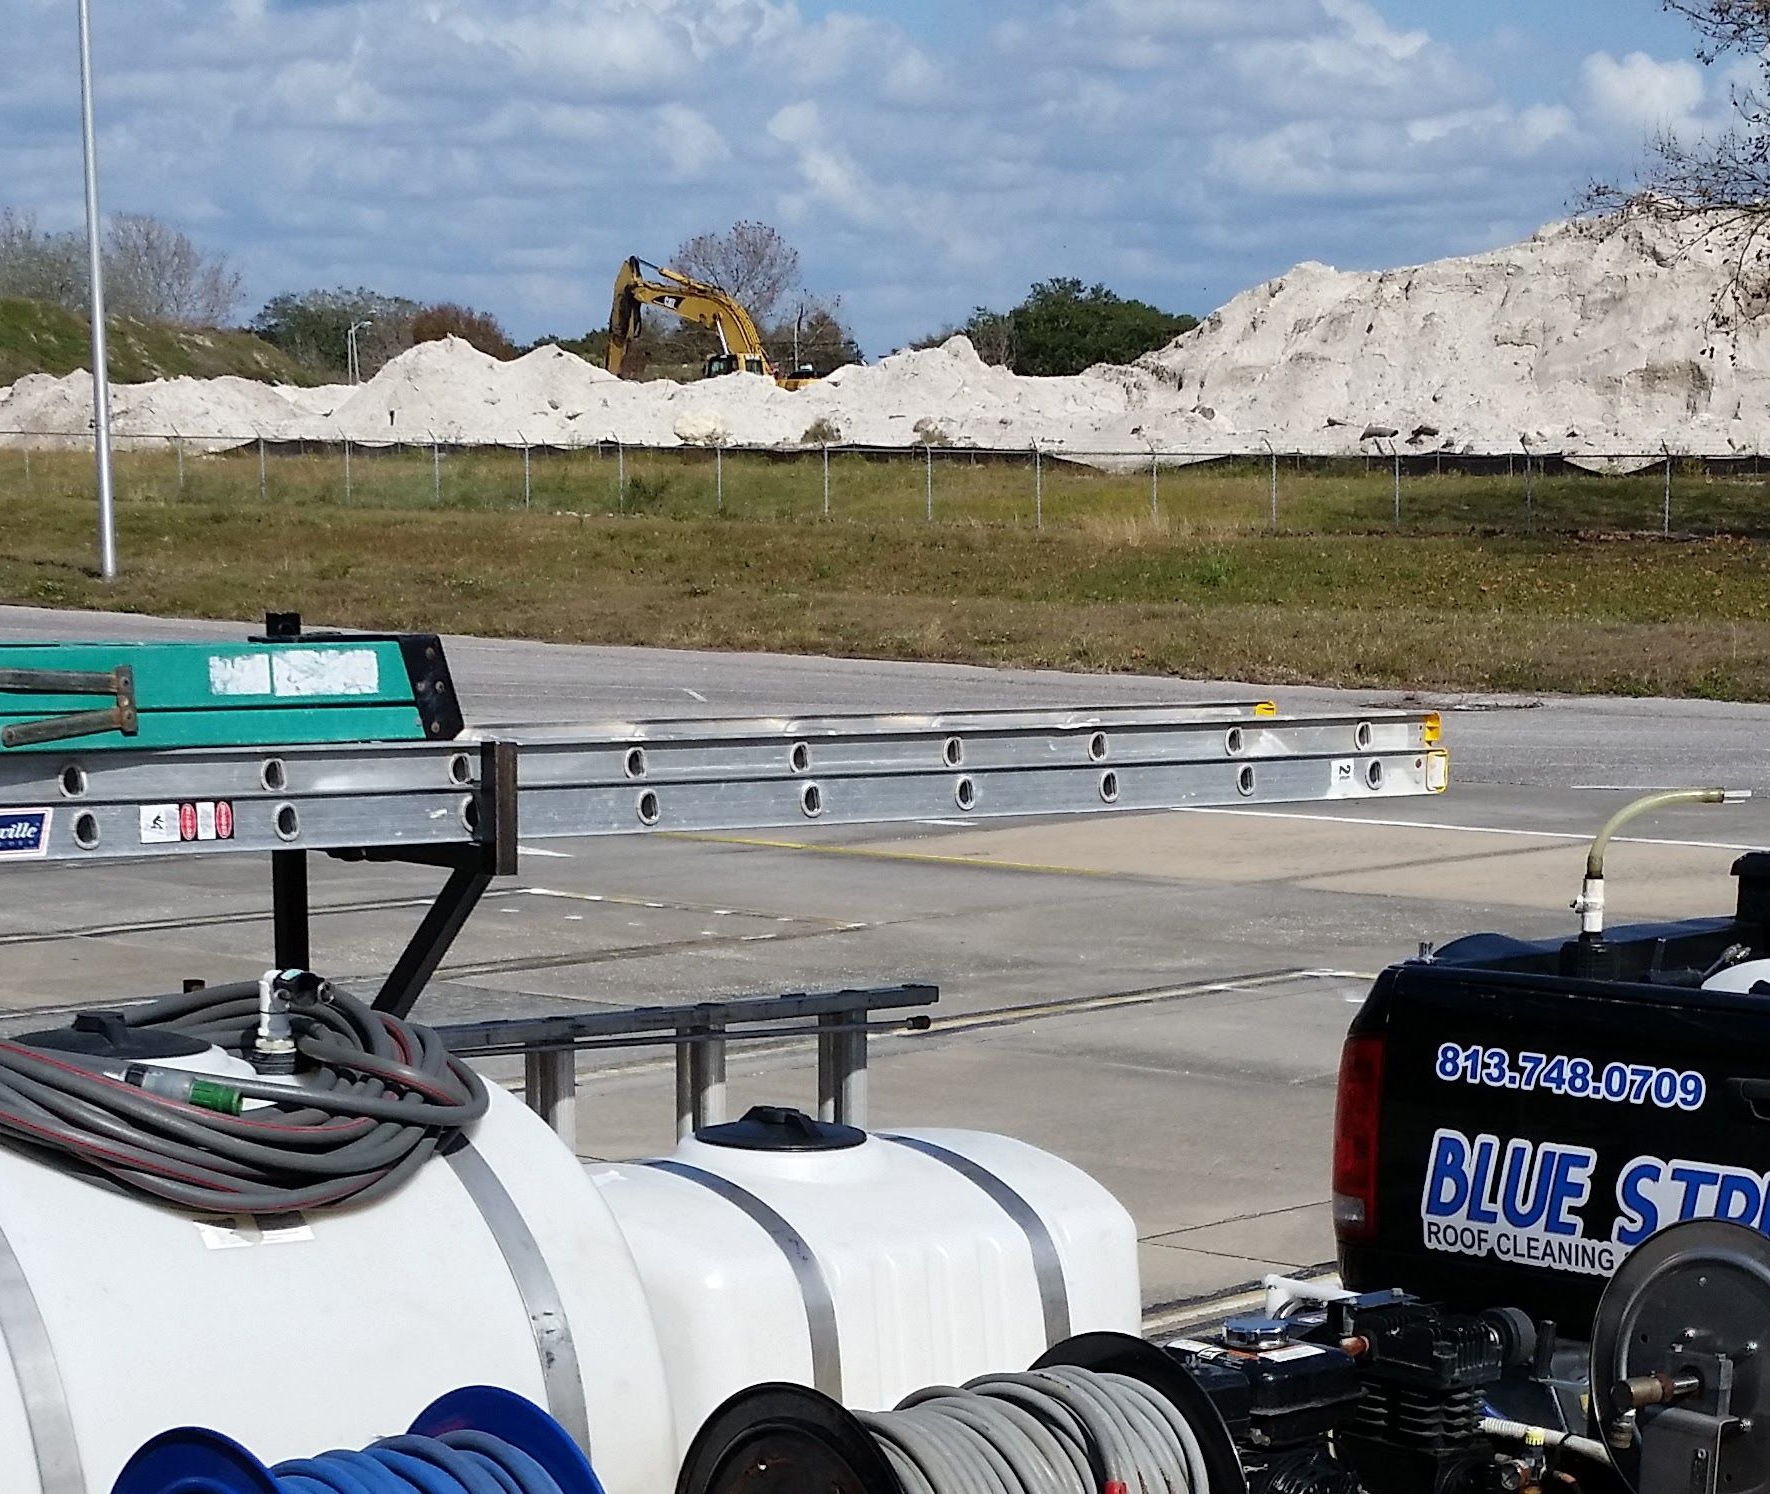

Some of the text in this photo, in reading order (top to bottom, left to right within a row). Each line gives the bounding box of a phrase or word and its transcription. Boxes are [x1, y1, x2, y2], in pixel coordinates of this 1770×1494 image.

[1437, 1043, 1704, 1109] 813.748.0709
[1426, 1136, 1591, 1235] BLUE
[1428, 1222, 1614, 1271] ROOF CLEANING
